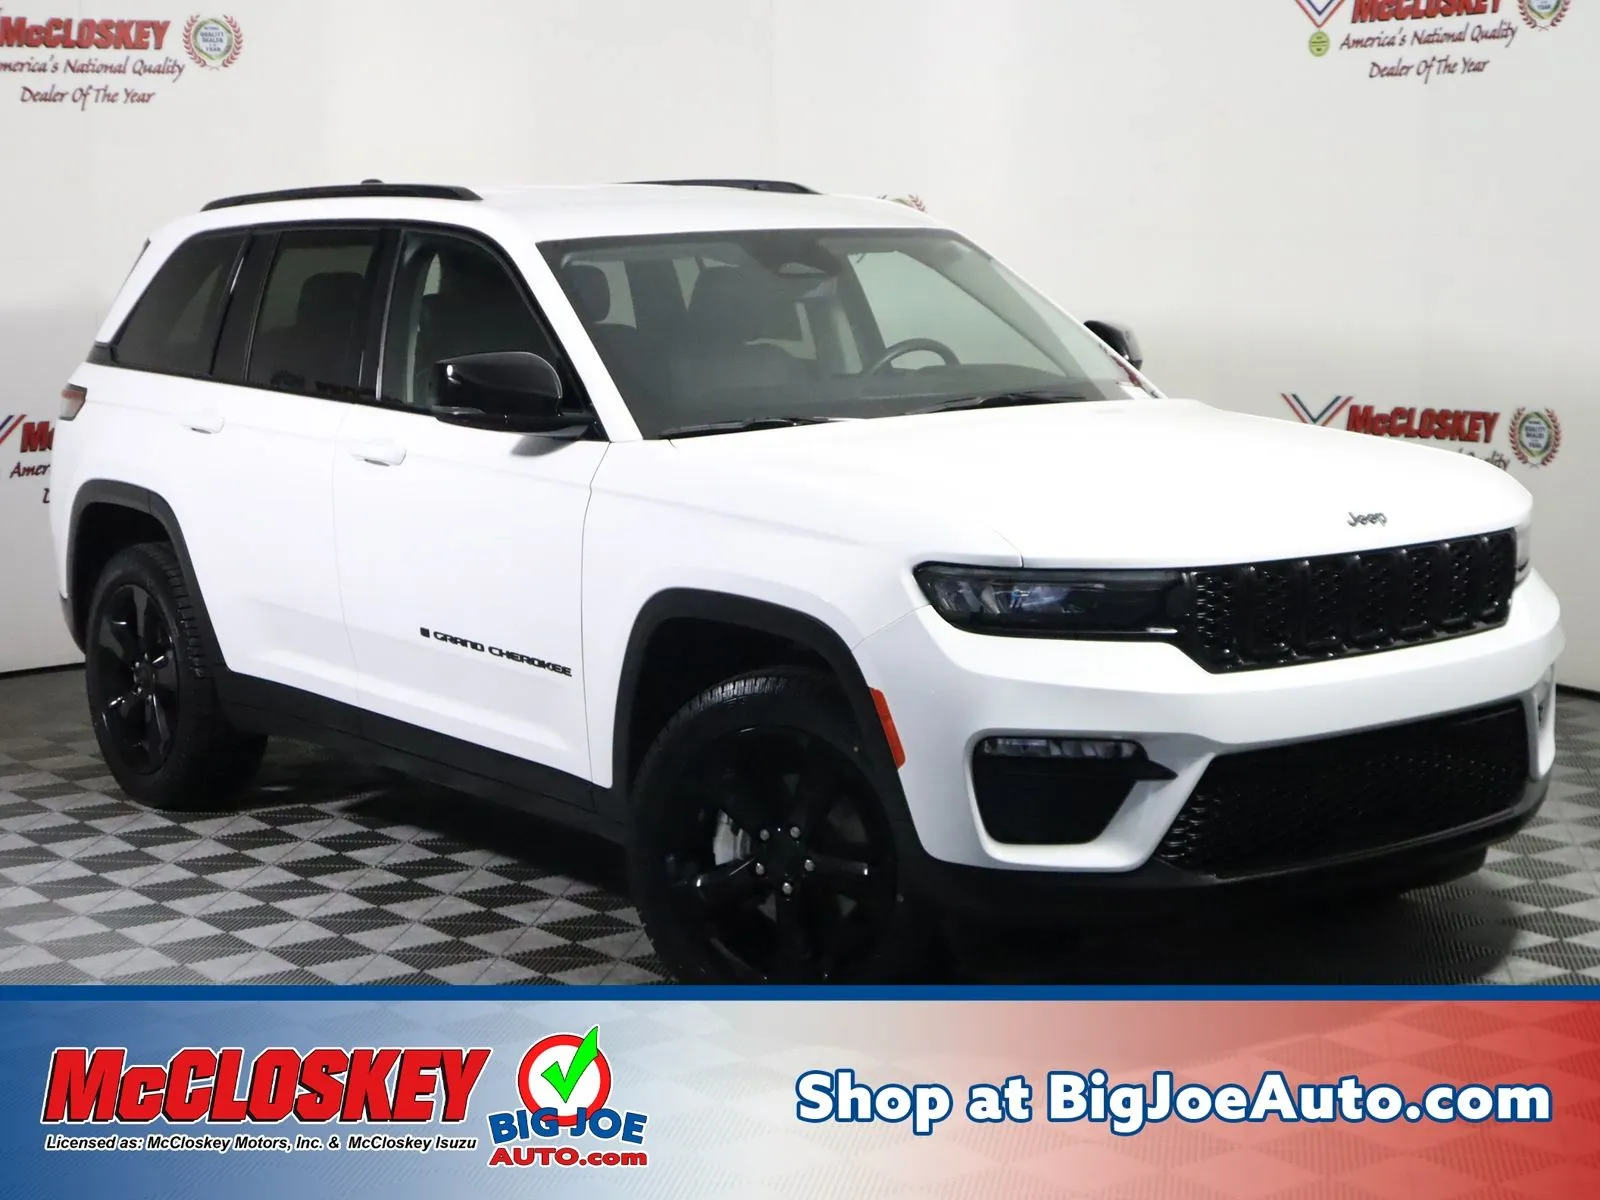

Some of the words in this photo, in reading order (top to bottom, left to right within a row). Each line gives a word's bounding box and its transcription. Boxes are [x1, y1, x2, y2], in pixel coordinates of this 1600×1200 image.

[0, 16, 170, 49] McCLOSKEY
[1339, 27, 1406, 50] America's
[1412, 24, 1466, 46] National
[1472, 20, 1518, 48] Quality
[0, 54, 58, 73] merica's
[63, 55, 128, 75] National
[132, 57, 185, 83] Quality
[1369, 57, 1413, 79] Dealer
[1416, 56, 1437, 85] Of
[1435, 57, 1458, 75] The
[1461, 56, 1490, 73] Year
[20, 84, 68, 103] Dealer
[71, 84, 92, 111] Of
[93, 87, 119, 103] The
[123, 90, 156, 104] Year
[1347, 405, 1501, 443] McCLOSKEY
[1347, 511, 1388, 528] Jeep
[433, 631, 485, 652] GRAND
[488, 646, 573, 677] CHEROKEE
